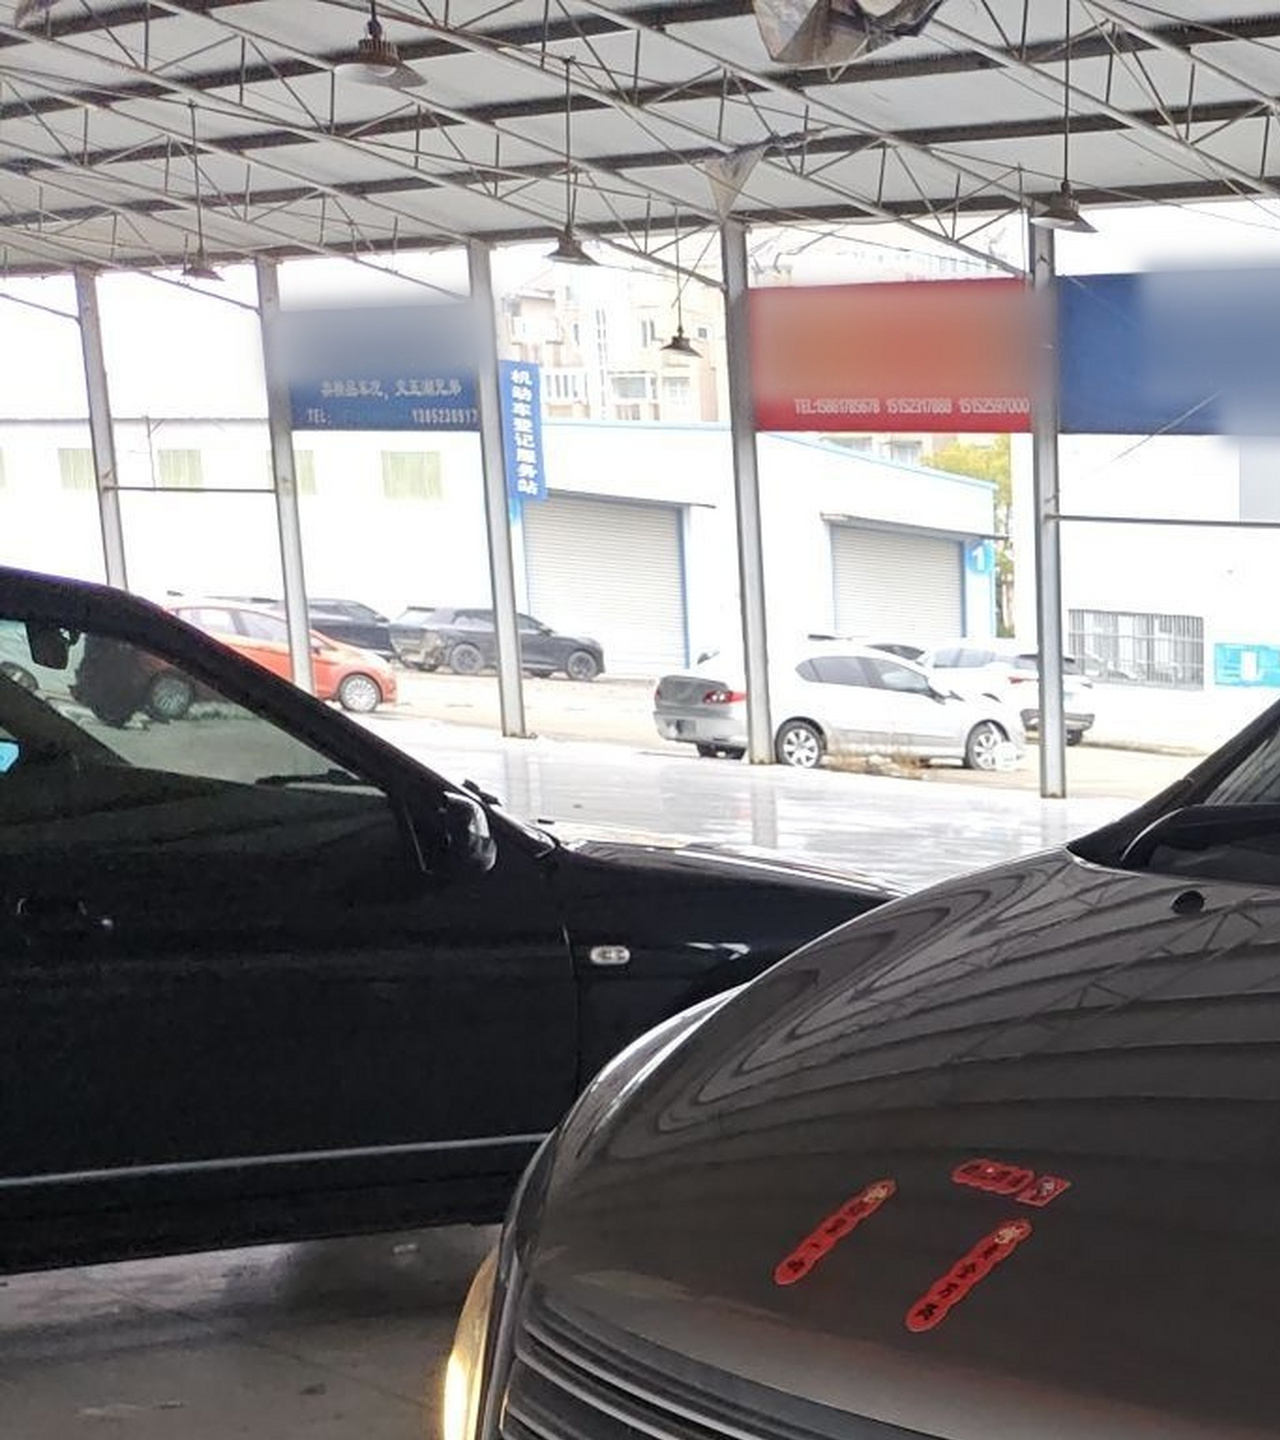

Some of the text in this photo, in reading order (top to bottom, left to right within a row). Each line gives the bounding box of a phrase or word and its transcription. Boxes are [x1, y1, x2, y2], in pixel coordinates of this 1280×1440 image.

[510, 369, 539, 496] 机动车登记服务站
